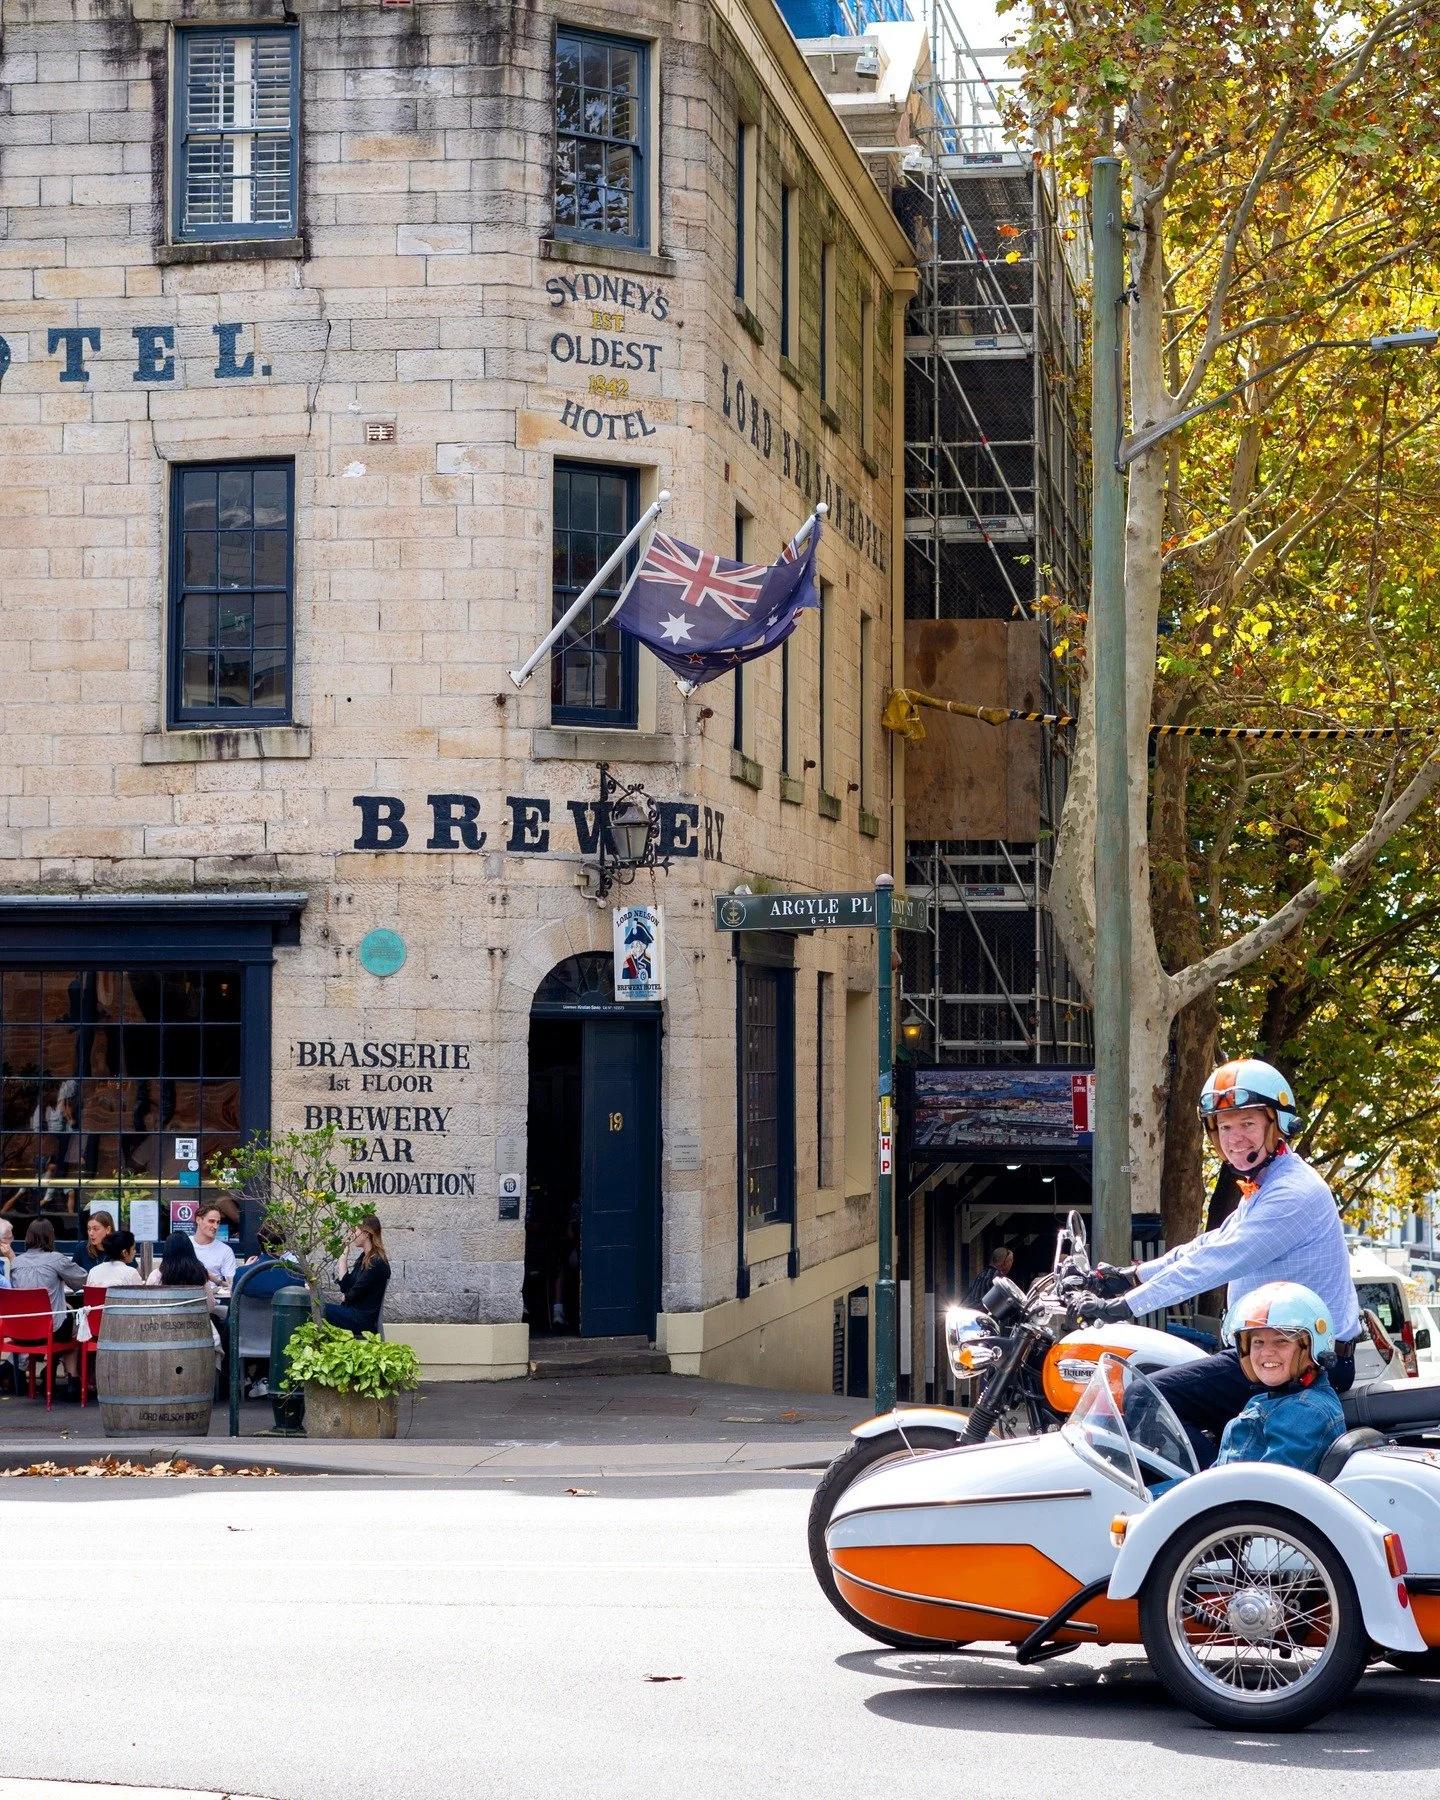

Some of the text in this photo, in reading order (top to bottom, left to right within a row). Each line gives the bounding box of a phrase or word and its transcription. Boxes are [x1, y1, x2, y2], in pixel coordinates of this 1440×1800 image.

[545, 273, 669, 321] SYDNEY'S
[0, 322, 272, 382] TEL.
[550, 332, 662, 372] OLDEST
[588, 374, 629, 399] 1842
[558, 399, 657, 441] HOTEL
[722, 361, 771, 459] LORD
[616, 909, 660, 927] LORD NELSON
[770, 897, 872, 916] ARGYLE PL
[811, 916, 816, 924] 6
[828, 916, 836, 924] 14
[296, 1041, 470, 1069] BRASSERIE
[327, 1073, 433, 1092] 1st FLOOR
[303, 1105, 452, 1132] BREWERY
[608, 1112, 623, 1131] 19
[349, 1137, 414, 1162] BAR
[505, 1182, 515, 1192] 18
[1063, 1368, 1094, 1377] TRIUMP
